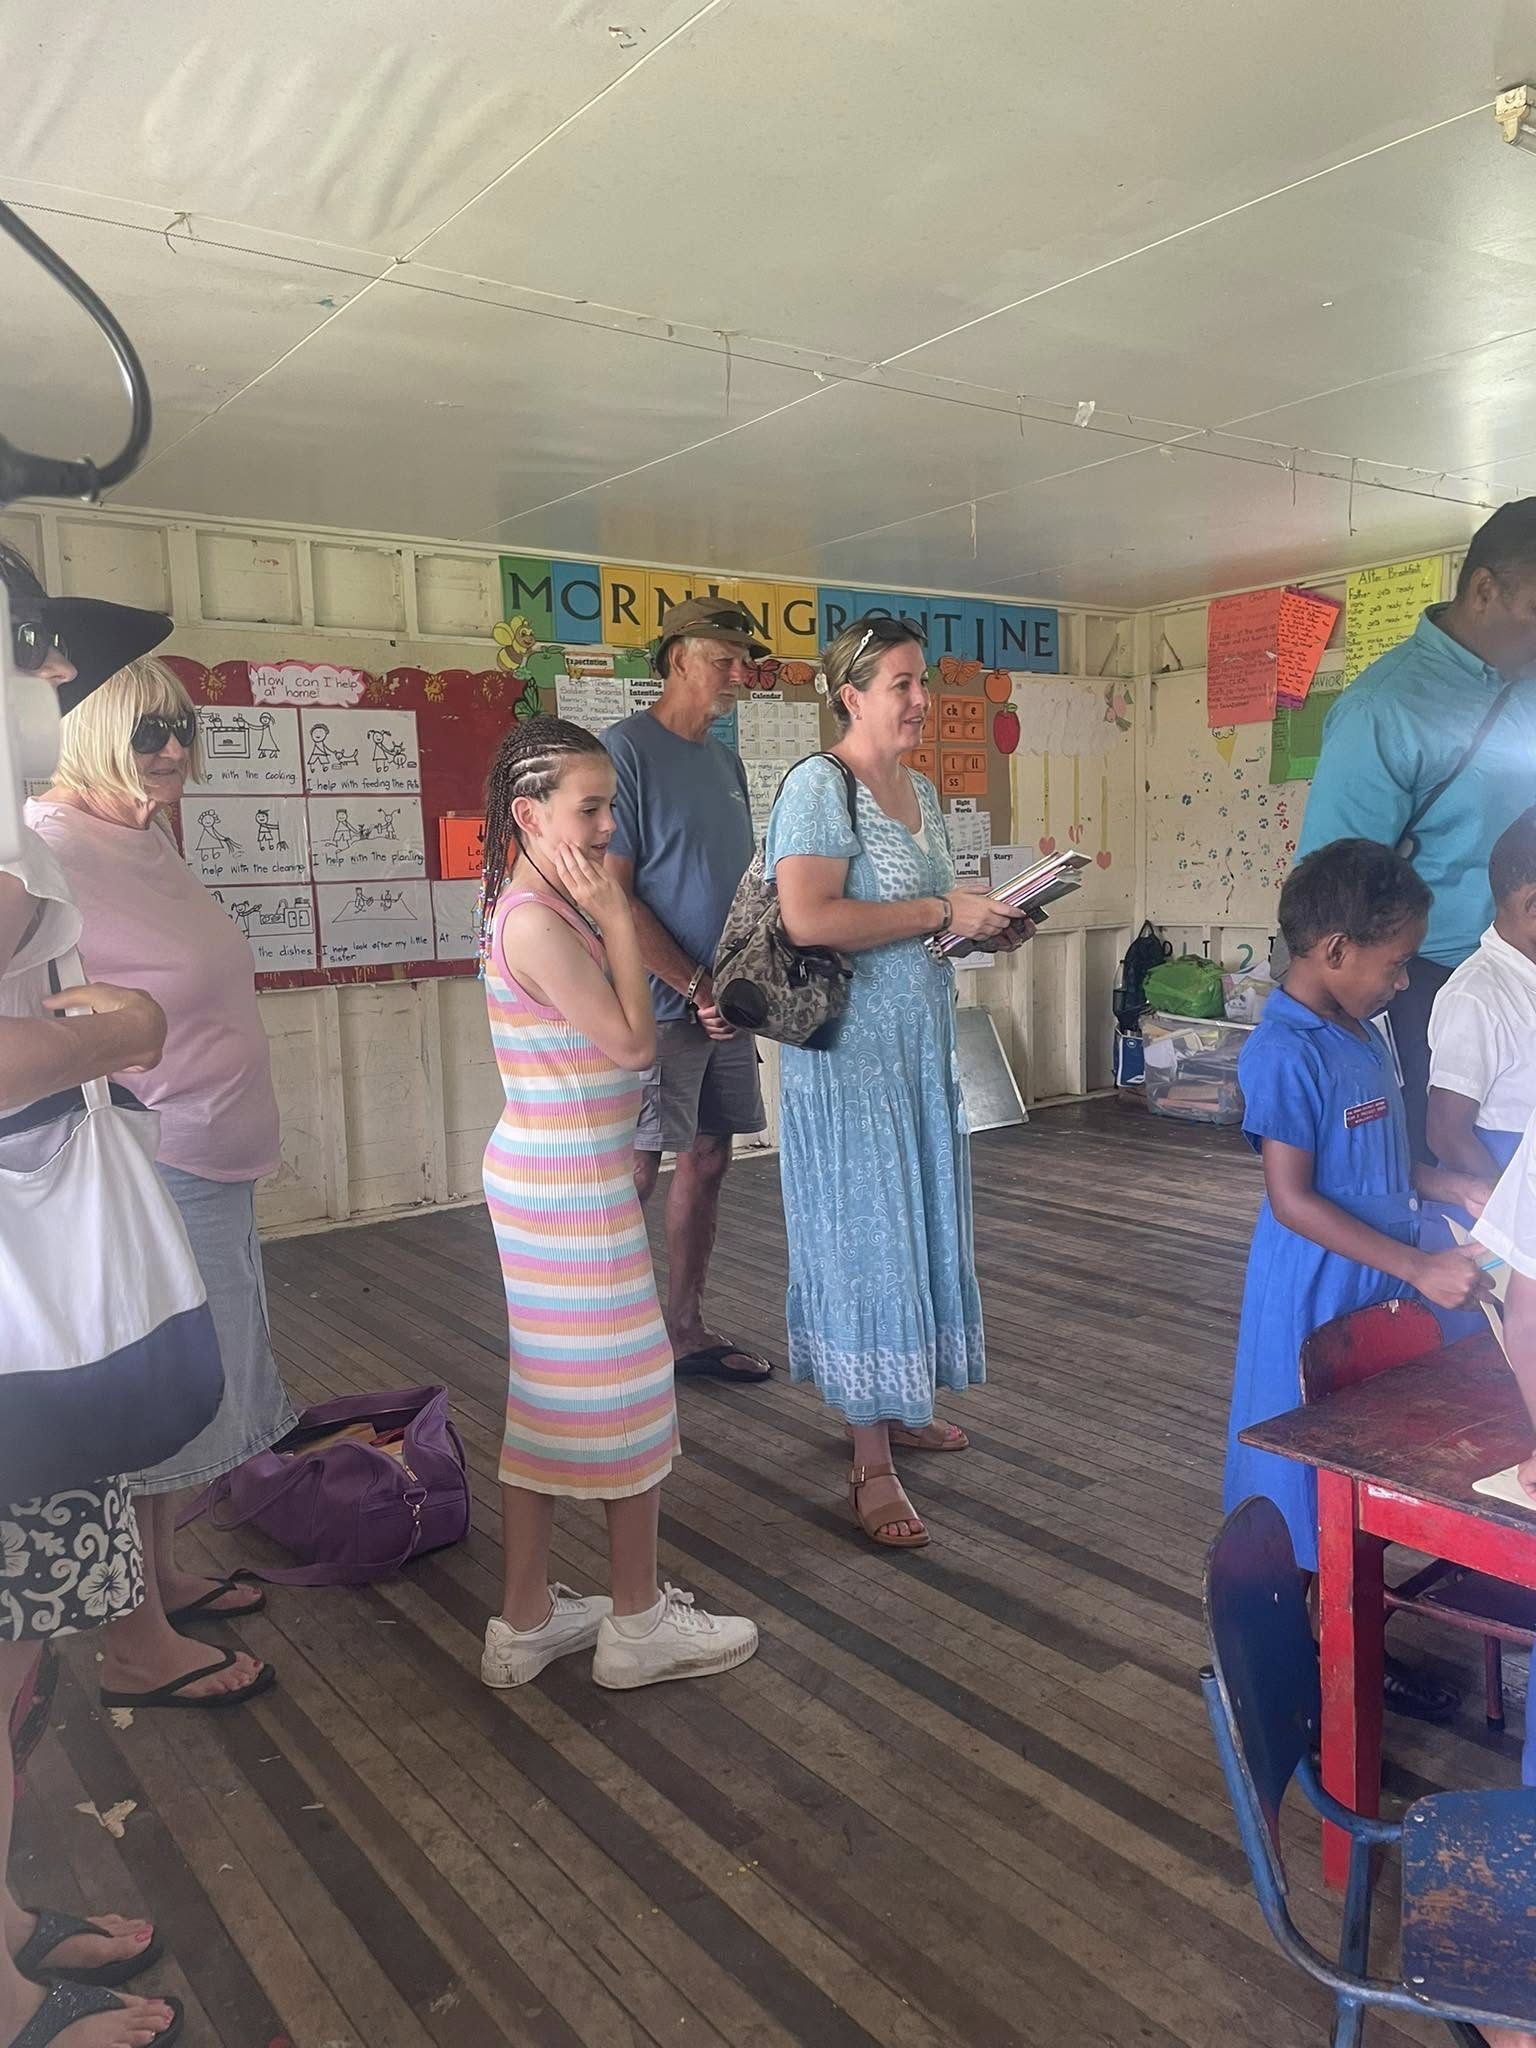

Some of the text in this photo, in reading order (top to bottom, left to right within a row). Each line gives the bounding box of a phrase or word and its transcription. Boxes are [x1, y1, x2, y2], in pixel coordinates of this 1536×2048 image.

[508, 572, 817, 641] MORNNG
[258, 672, 359, 692] How can I help
[630, 680, 663, 688] Learning
[1311, 675, 1344, 690] AVIOR
[264, 687, 277, 697] at
[751, 691, 782, 700] Calendar
[946, 704, 958, 716] ck
[971, 706, 977, 715] e
[920, 755, 926, 763] n
[222, 770, 240, 781] with
[245, 770, 261, 781] the
[265, 770, 297, 787] cooking
[306, 779, 314, 792] I
[316, 778, 337, 792] help
[341, 778, 359, 790] with
[361, 775, 392, 791] feeding
[392, 777, 405, 789] the
[949, 778, 959, 787] ss
[312, 851, 424, 867] I help with the planting
[967, 853, 980, 861] Days
[993, 853, 1013, 861] Story:
[201, 863, 224, 877] help
[231, 862, 250, 874] with
[253, 862, 269, 874] the
[956, 869, 980, 877] Learning
[438, 933, 475, 945] At my
[321, 935, 429, 956] I help look after my little
[257, 946, 273, 959] the
